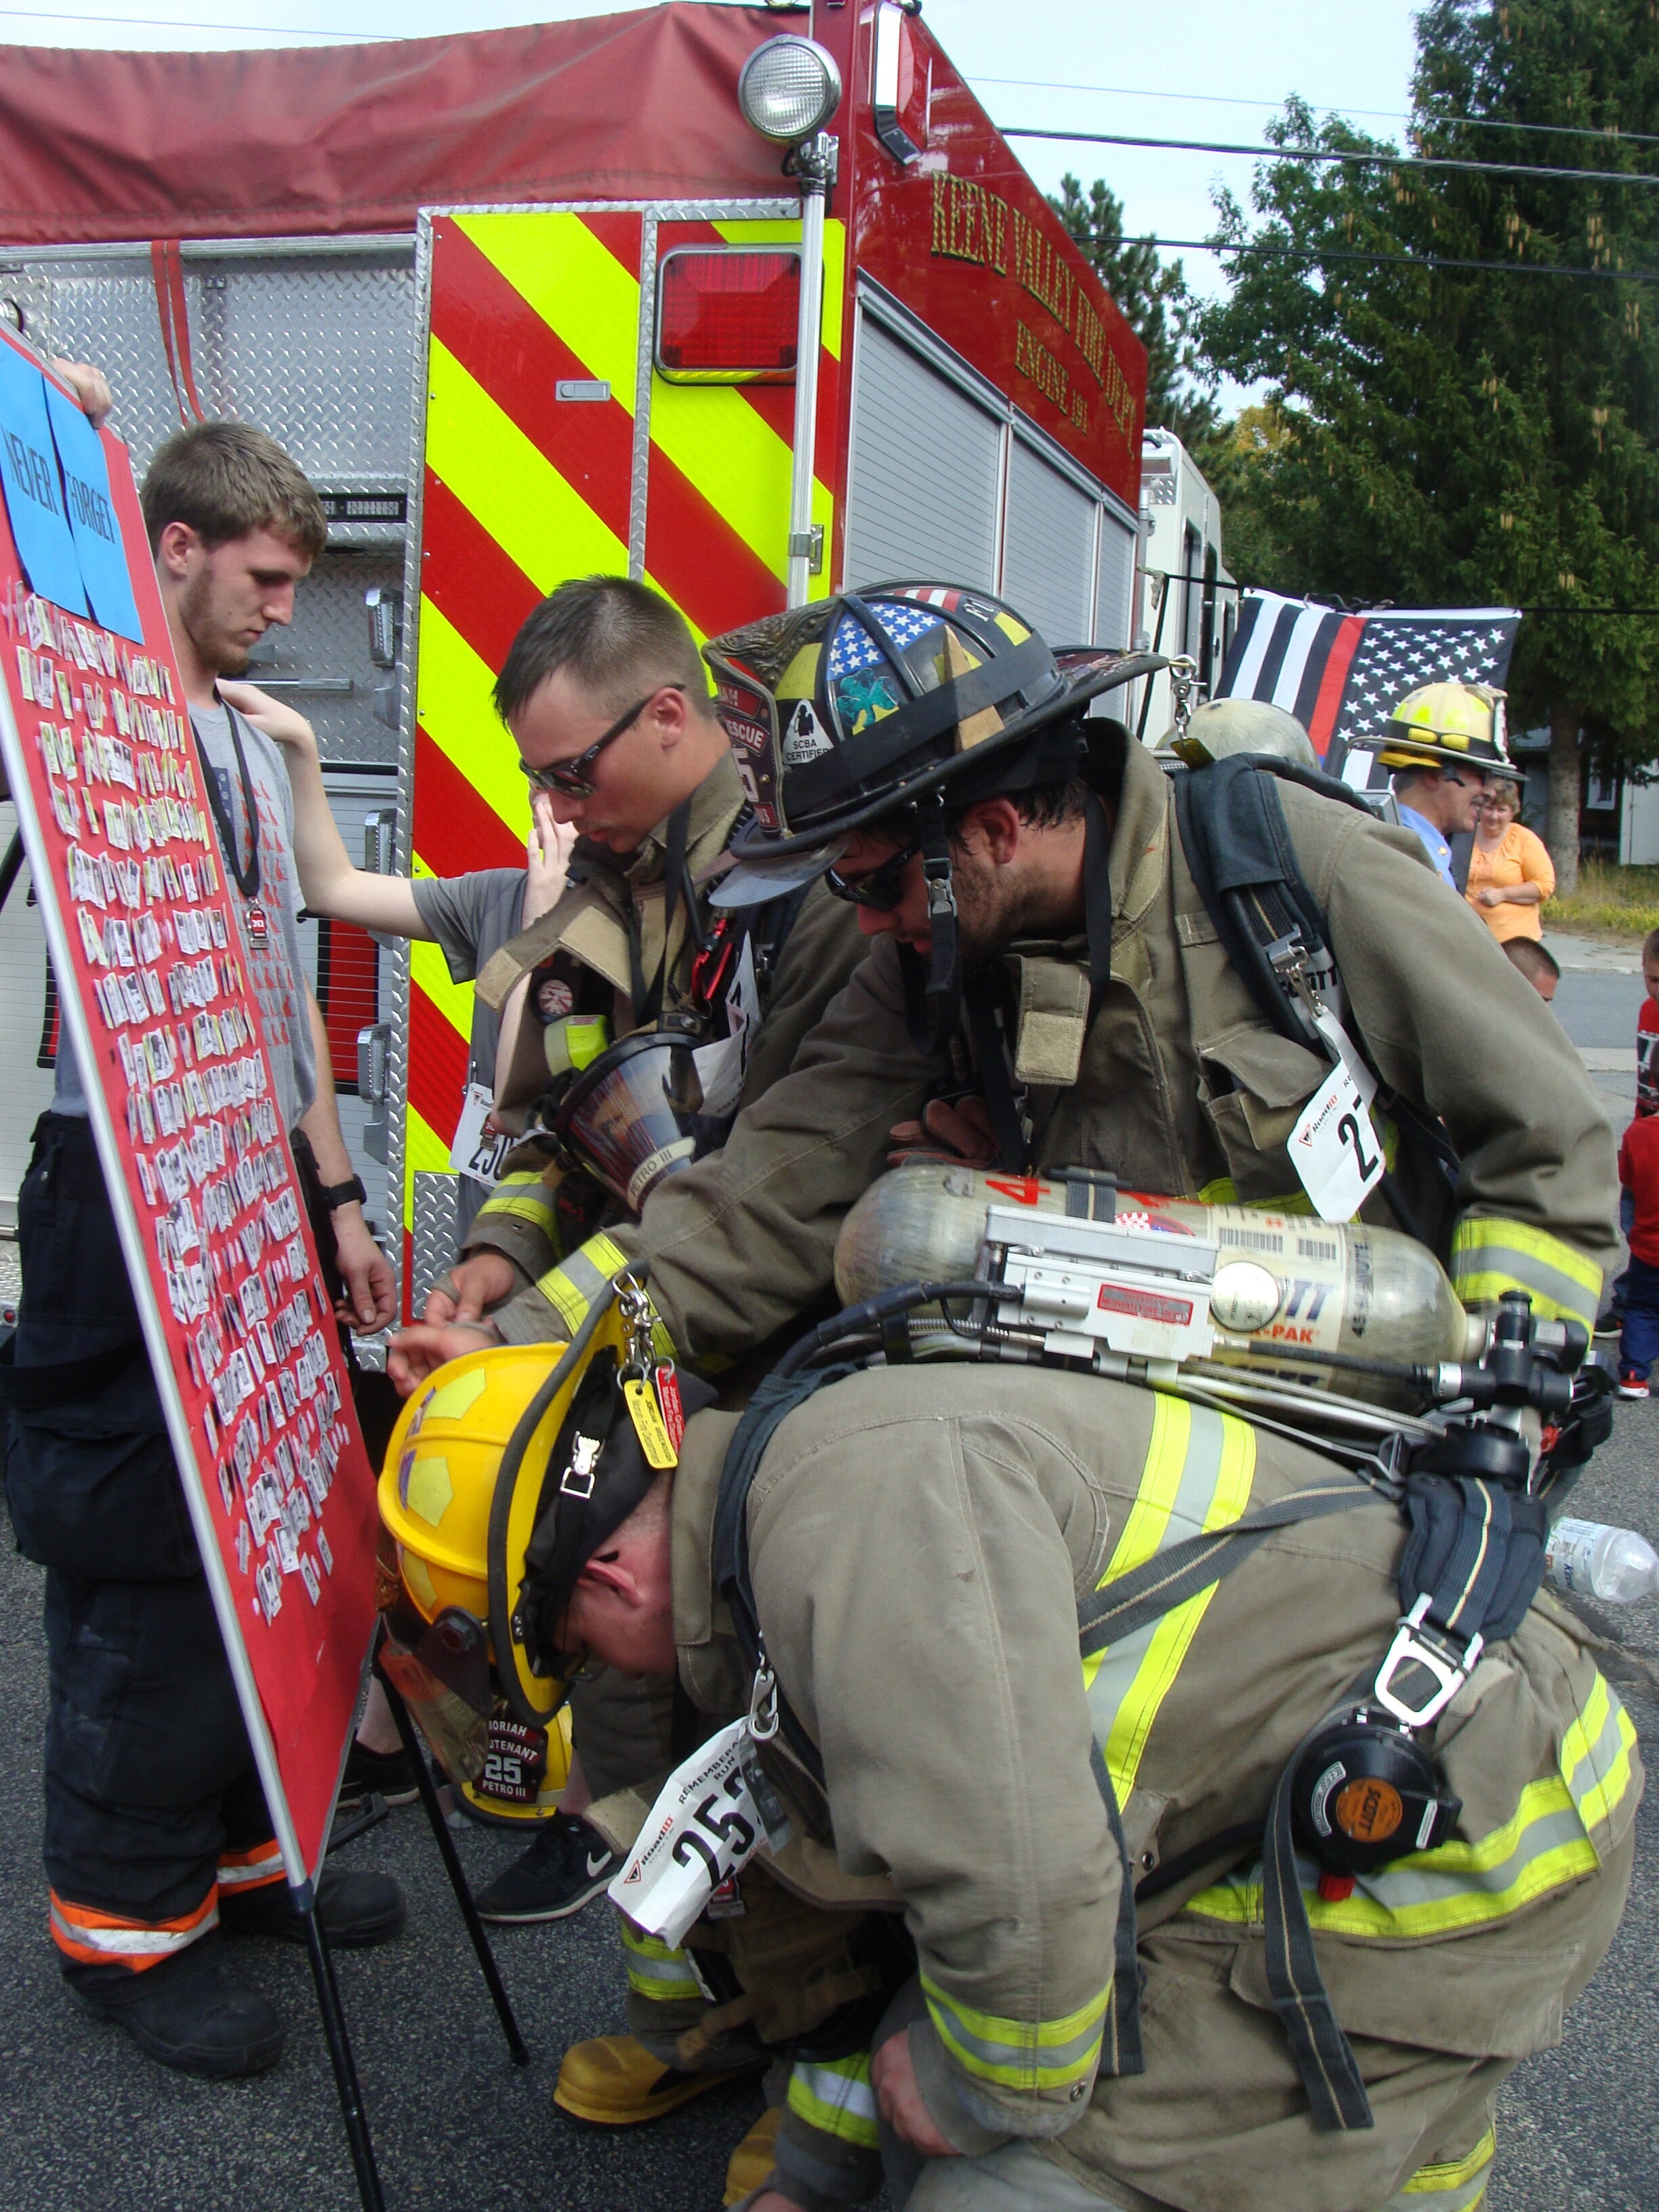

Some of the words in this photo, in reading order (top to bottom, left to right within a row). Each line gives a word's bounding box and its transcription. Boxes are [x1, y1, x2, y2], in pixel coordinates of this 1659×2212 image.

[930, 168, 1008, 278] KEENE
[1012, 206, 1076, 333] VALLEY
[1074, 285, 1106, 390] FIRE
[1014, 318, 1069, 415] ENGINE
[1, 422, 60, 517] NEVER
[65, 469, 115, 544] FORGET
[726, 719, 765, 749] ESCUE
[793, 739, 817, 750] SCBA
[630, 1161, 657, 1197] PETRO
[659, 1149, 672, 1164] III
[485, 1753, 522, 1784] 25
[489, 1738, 538, 1761] UTENANT
[714, 1756, 736, 1782] RUN
[482, 1780, 514, 1795] PETRO
[515, 1786, 526, 1797] III
[678, 1741, 739, 1805] REMEMBERA
[641, 1816, 674, 1866] RoadID
